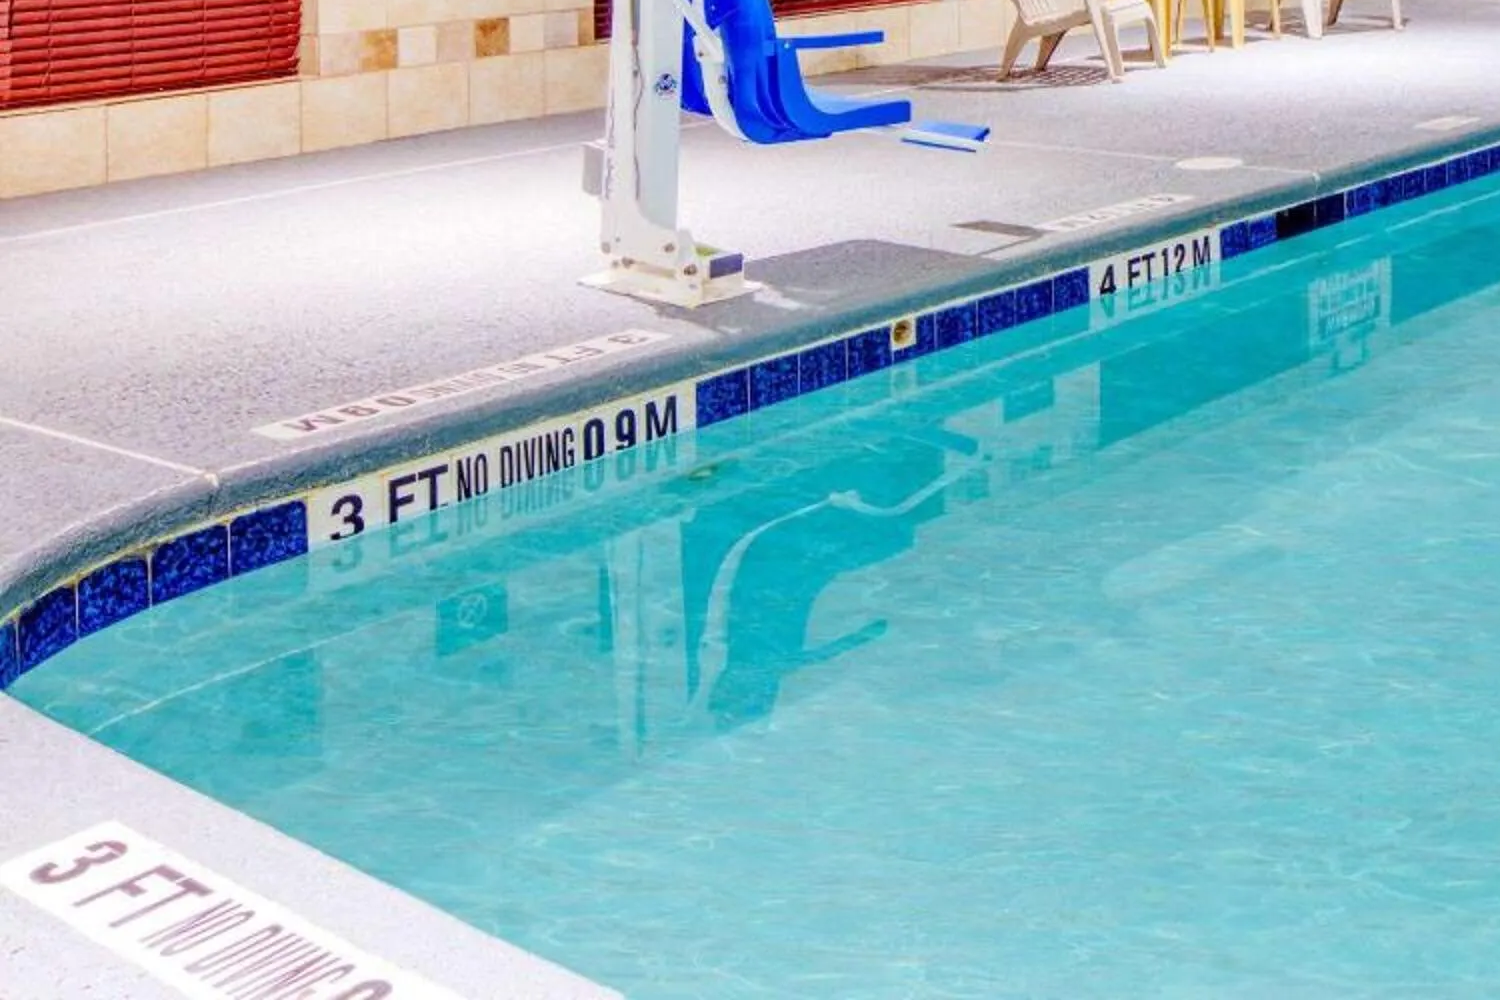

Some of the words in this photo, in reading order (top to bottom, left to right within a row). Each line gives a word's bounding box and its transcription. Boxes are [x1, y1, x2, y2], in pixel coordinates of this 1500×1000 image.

[1099, 263, 1117, 296] 4
[1127, 251, 1156, 288] FT
[329, 493, 365, 541] 3
[456, 453, 489, 503] NO
[499, 427, 575, 489] DIVING
[29, 840, 128, 884] 3
[72, 864, 214, 928] FT
[138, 898, 257, 956] NO
[183, 924, 356, 1000] DIVING
